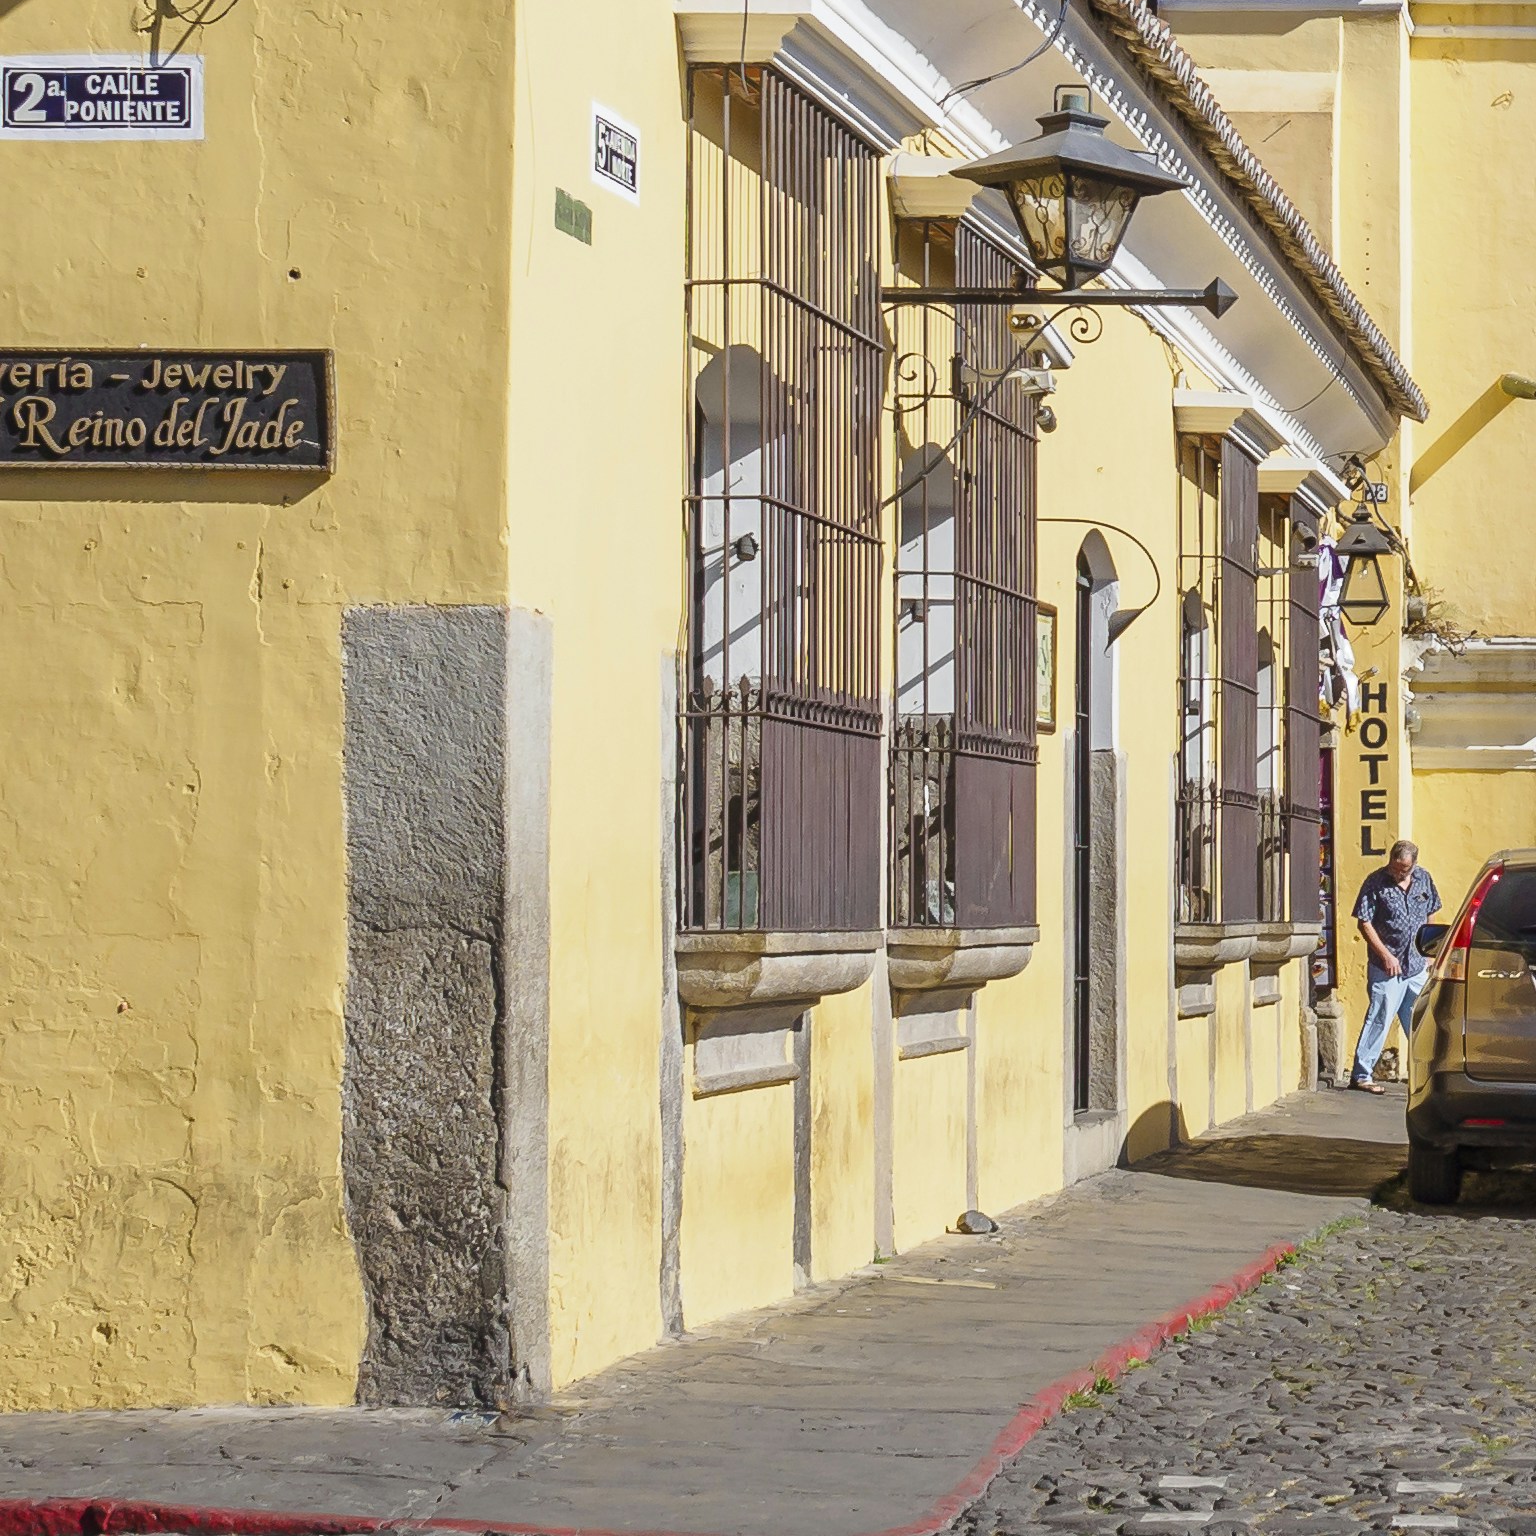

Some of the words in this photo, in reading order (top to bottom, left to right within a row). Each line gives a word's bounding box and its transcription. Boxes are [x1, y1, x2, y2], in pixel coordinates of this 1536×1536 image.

[86, 75, 160, 95] CALLE
[66, 100, 181, 121] PONIENTE
[0, 357, 93, 389] ería
[142, 359, 288, 395] Jewelry
[13, 395, 147, 455] Reino
[153, 397, 220, 448] del
[209, 397, 304, 455] Jade
[1359, 682, 1389, 857] HOTEL
